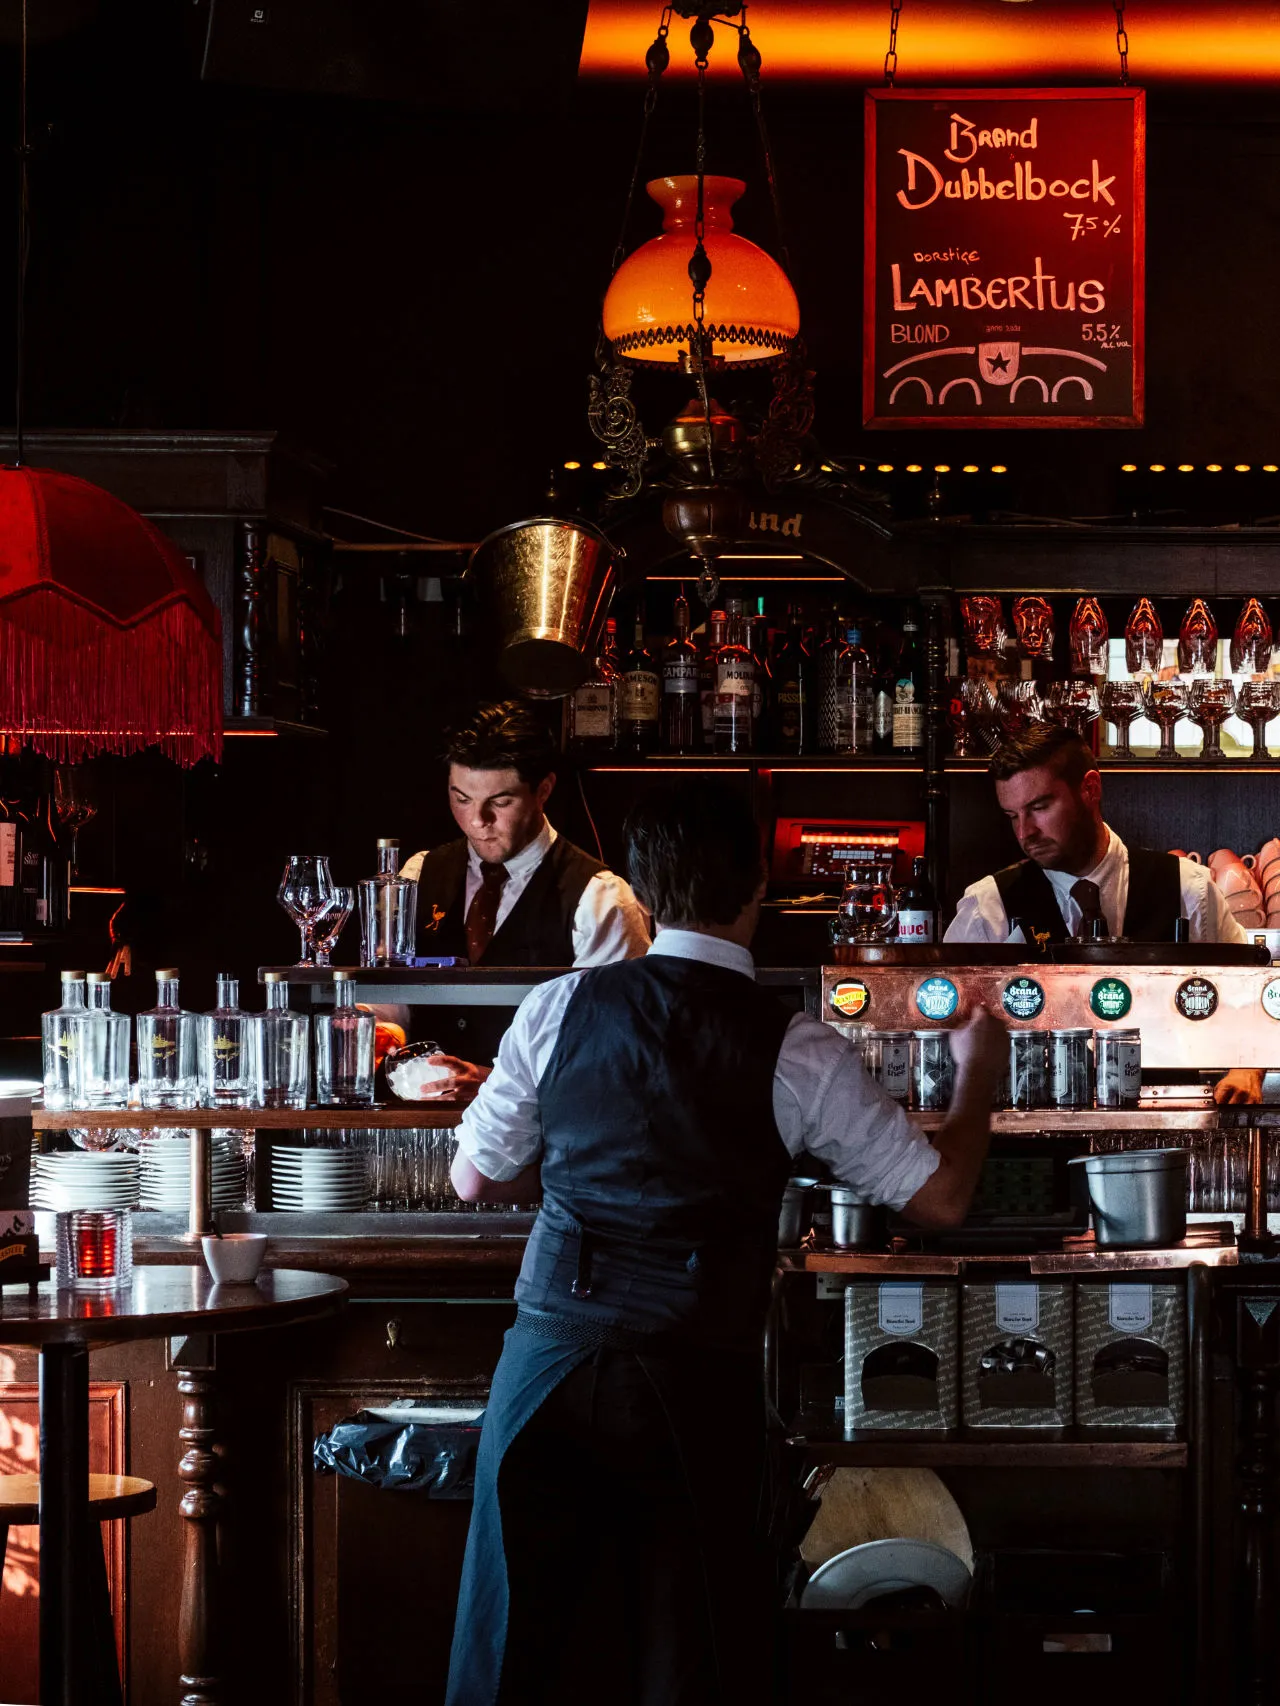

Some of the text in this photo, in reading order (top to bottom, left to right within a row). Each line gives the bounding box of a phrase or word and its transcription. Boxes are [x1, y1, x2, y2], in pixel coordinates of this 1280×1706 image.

[944, 113, 1037, 163] Brand
[896, 148, 1117, 210] Dubbelbock
[891, 324, 951, 344] BLOND
[663, 666, 699, 678] CAMPAR
[1009, 986, 1038, 996] Brand
[1098, 990, 1125, 1000] Brand
